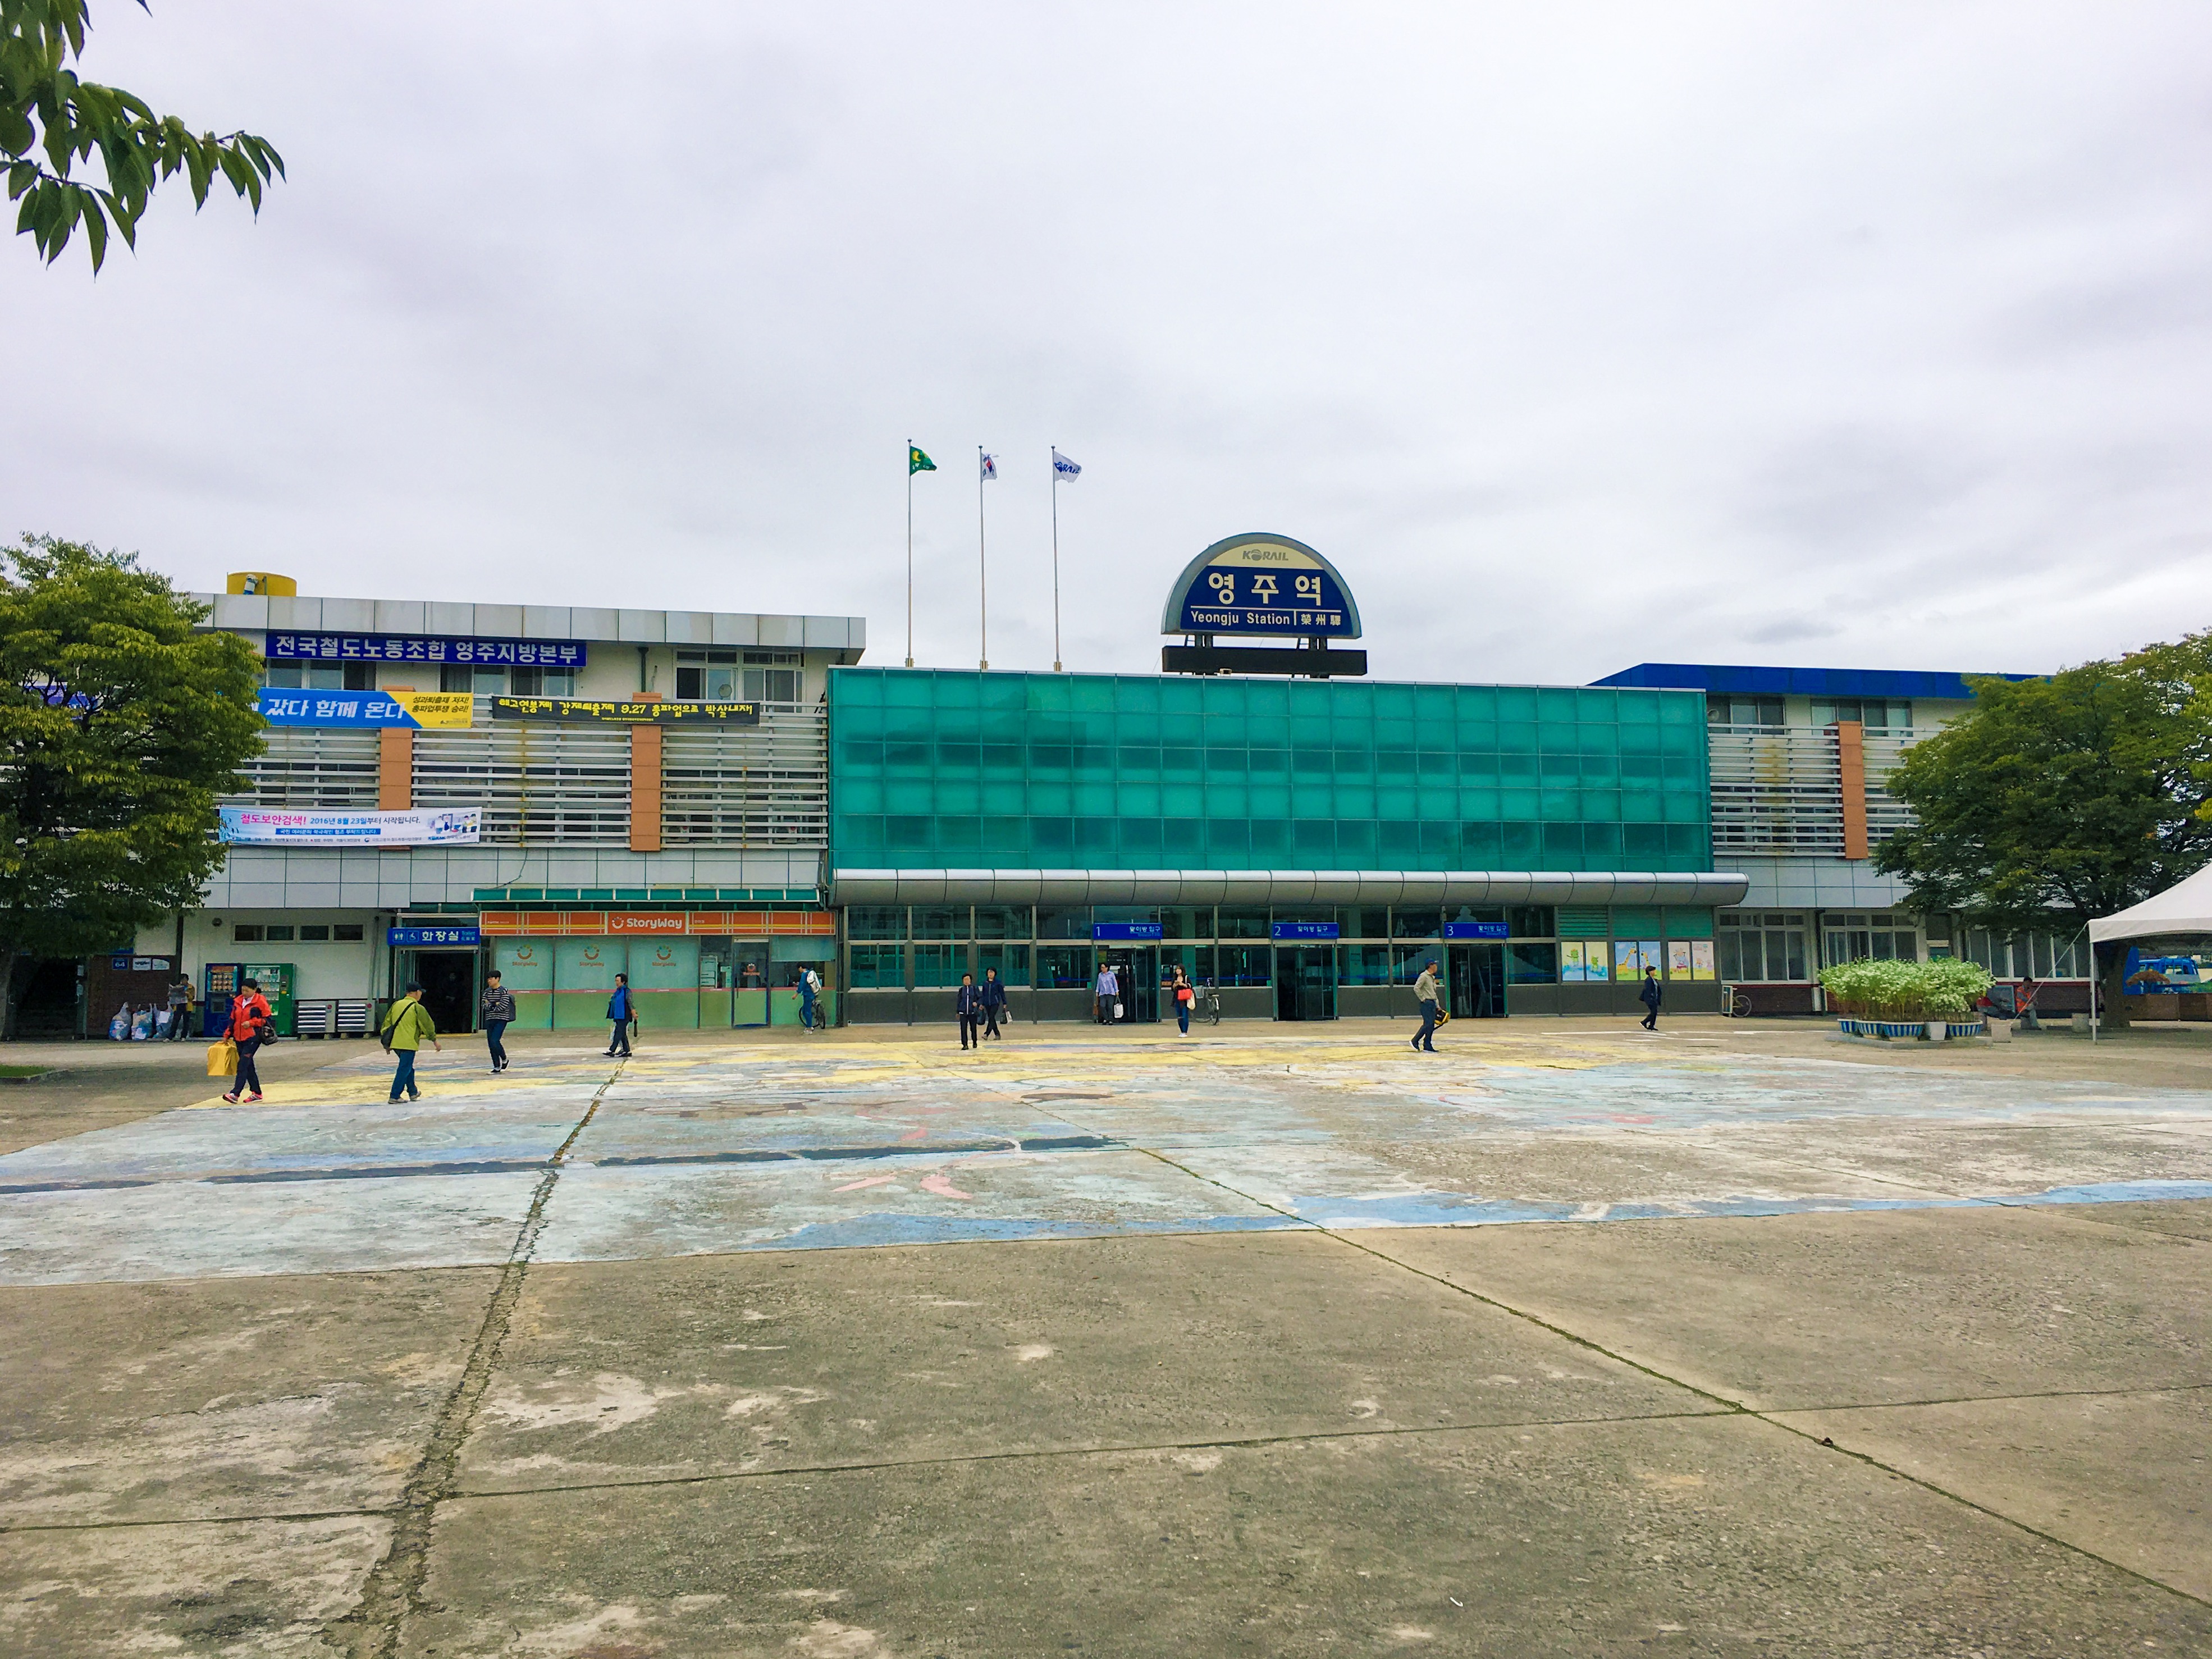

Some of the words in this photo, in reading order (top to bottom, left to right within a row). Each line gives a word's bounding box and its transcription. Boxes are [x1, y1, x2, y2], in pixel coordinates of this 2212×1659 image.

[1242, 549, 1288, 561] KORAIL
[1208, 572, 1320, 606] 영주역
[1191, 610, 1239, 625] Yeongju
[1247, 612, 1290, 625] Station
[1301, 613, 1341, 626] 榮州驛
[276, 635, 447, 659] 전국철도노동조합
[456, 641, 577, 664] 영주지방본부
[266, 698, 309, 716] 갔다
[316, 700, 359, 718] 함께
[364, 702, 406, 719] 온다
[499, 698, 552, 714] 해고연봉제
[559, 702, 615, 716] 강제퇴출제
[621, 705, 647, 714] 9.27
[652, 705, 699, 717] 총파업으로
[241, 813, 306, 825] 철도보안검색!
[627, 918, 682, 929] StoryWay
[422, 931, 459, 942] 화장실
[1096, 926, 1100, 936] 1
[1274, 926, 1281, 936] 2
[1448, 926, 1454, 936] 3
